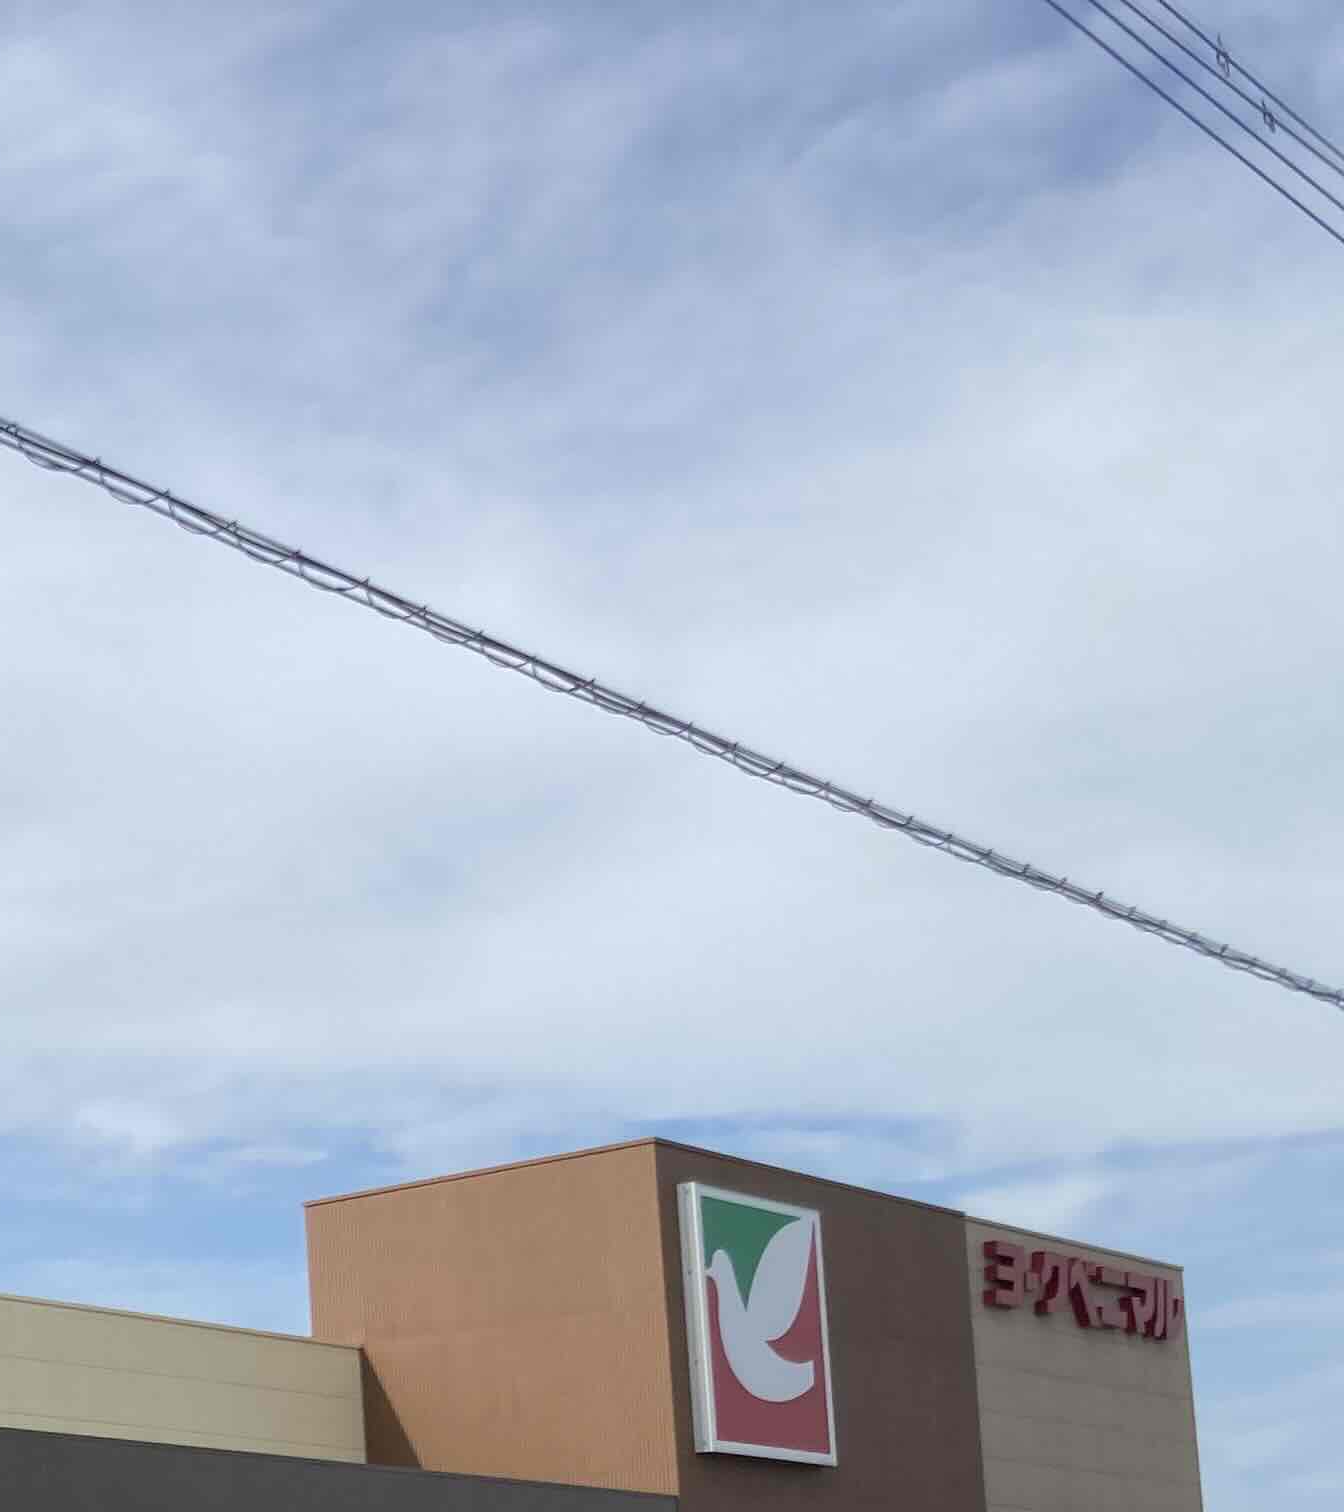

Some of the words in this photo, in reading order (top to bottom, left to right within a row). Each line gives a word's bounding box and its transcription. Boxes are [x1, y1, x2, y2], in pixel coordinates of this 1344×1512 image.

[982, 1241, 1184, 1343] ヨークベニマル
